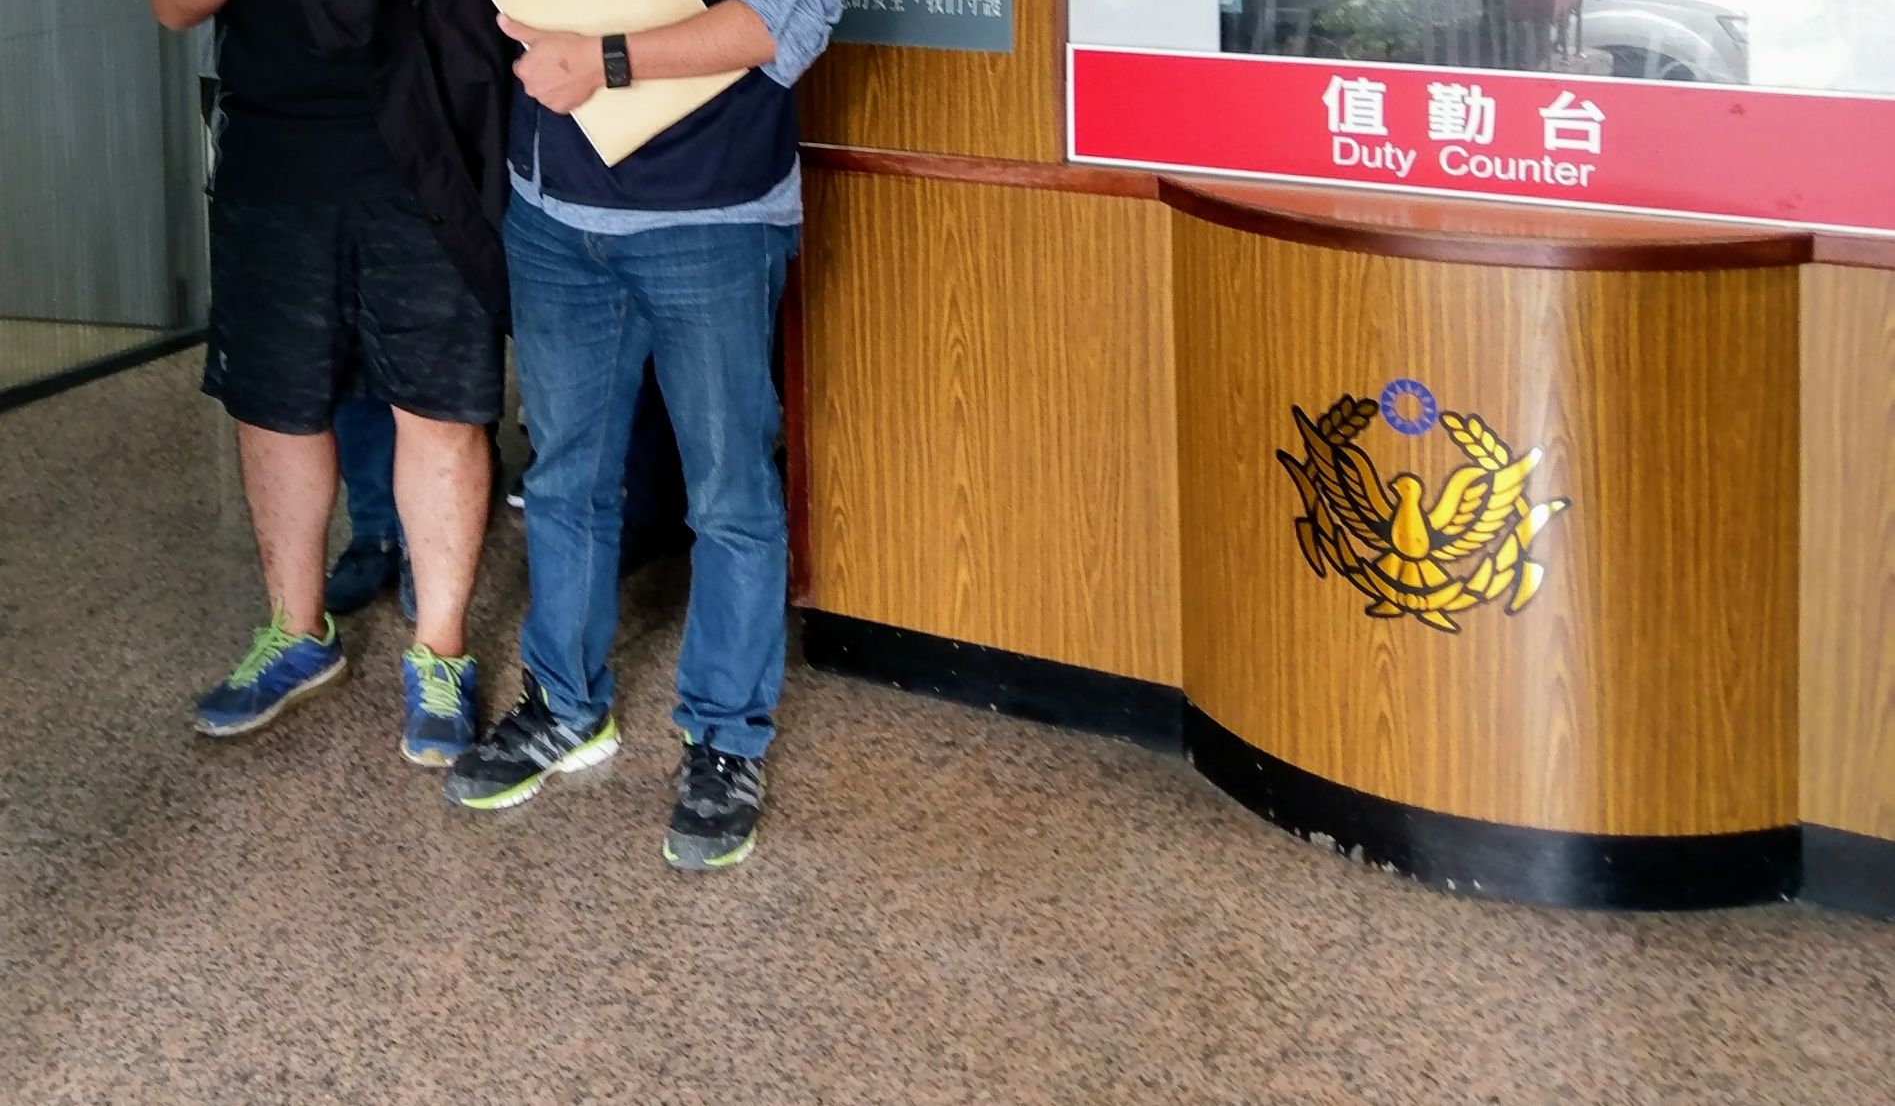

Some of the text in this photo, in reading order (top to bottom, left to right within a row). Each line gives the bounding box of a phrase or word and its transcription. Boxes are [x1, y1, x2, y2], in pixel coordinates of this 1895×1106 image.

[1322, 75, 1606, 154] 值勤台
[1332, 136, 1597, 187] Duty Counter
